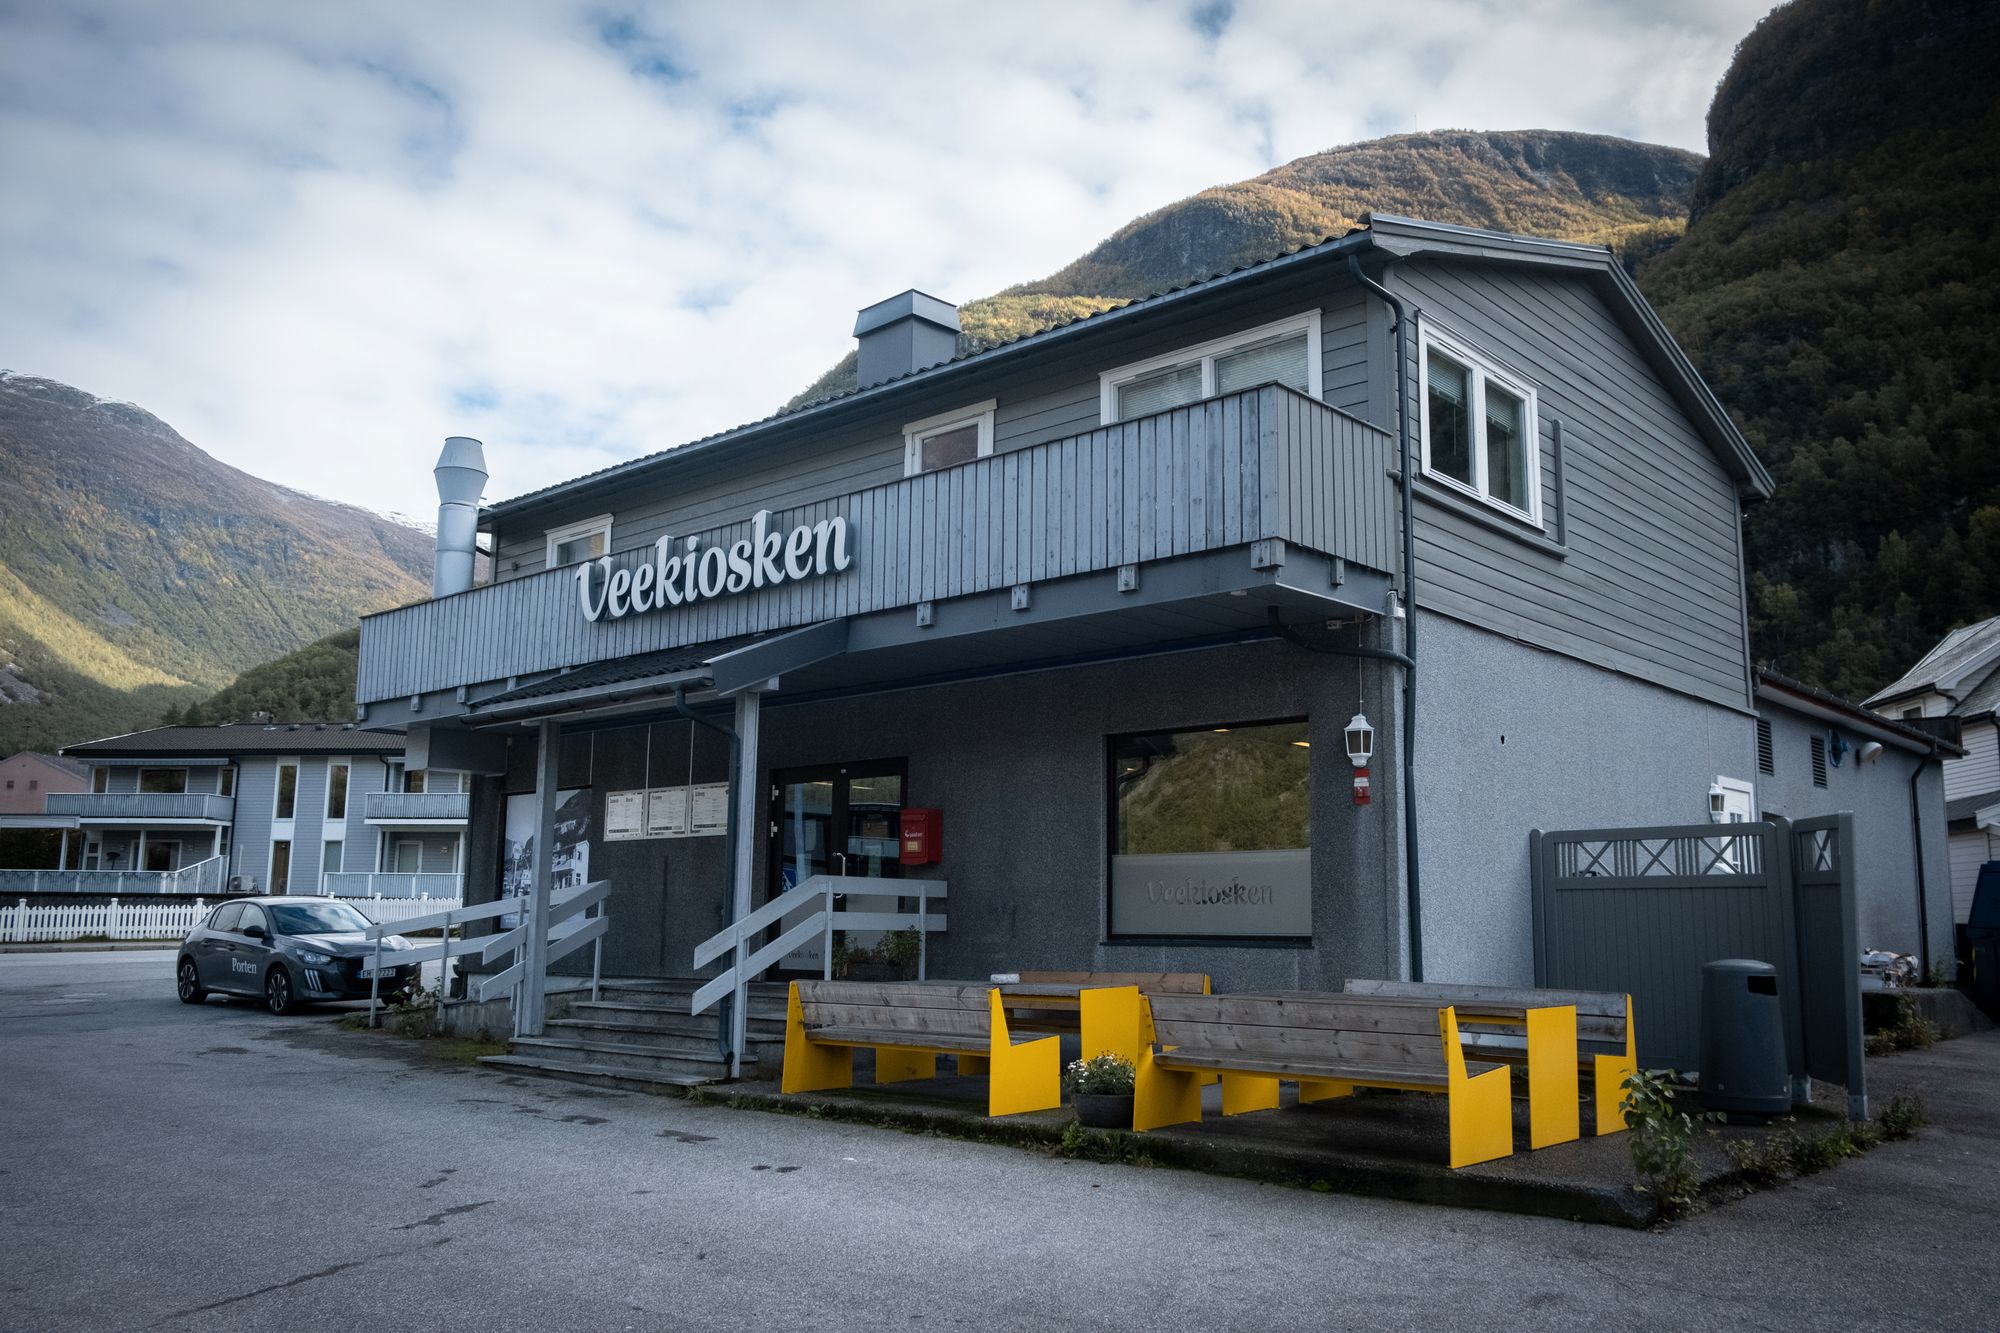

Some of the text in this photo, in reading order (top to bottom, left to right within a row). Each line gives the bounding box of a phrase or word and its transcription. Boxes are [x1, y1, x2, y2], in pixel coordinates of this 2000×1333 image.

[575, 509, 853, 622] Veekiosken
[1144, 875, 1273, 905] Veekiosken
[231, 957, 257, 974] Porten
